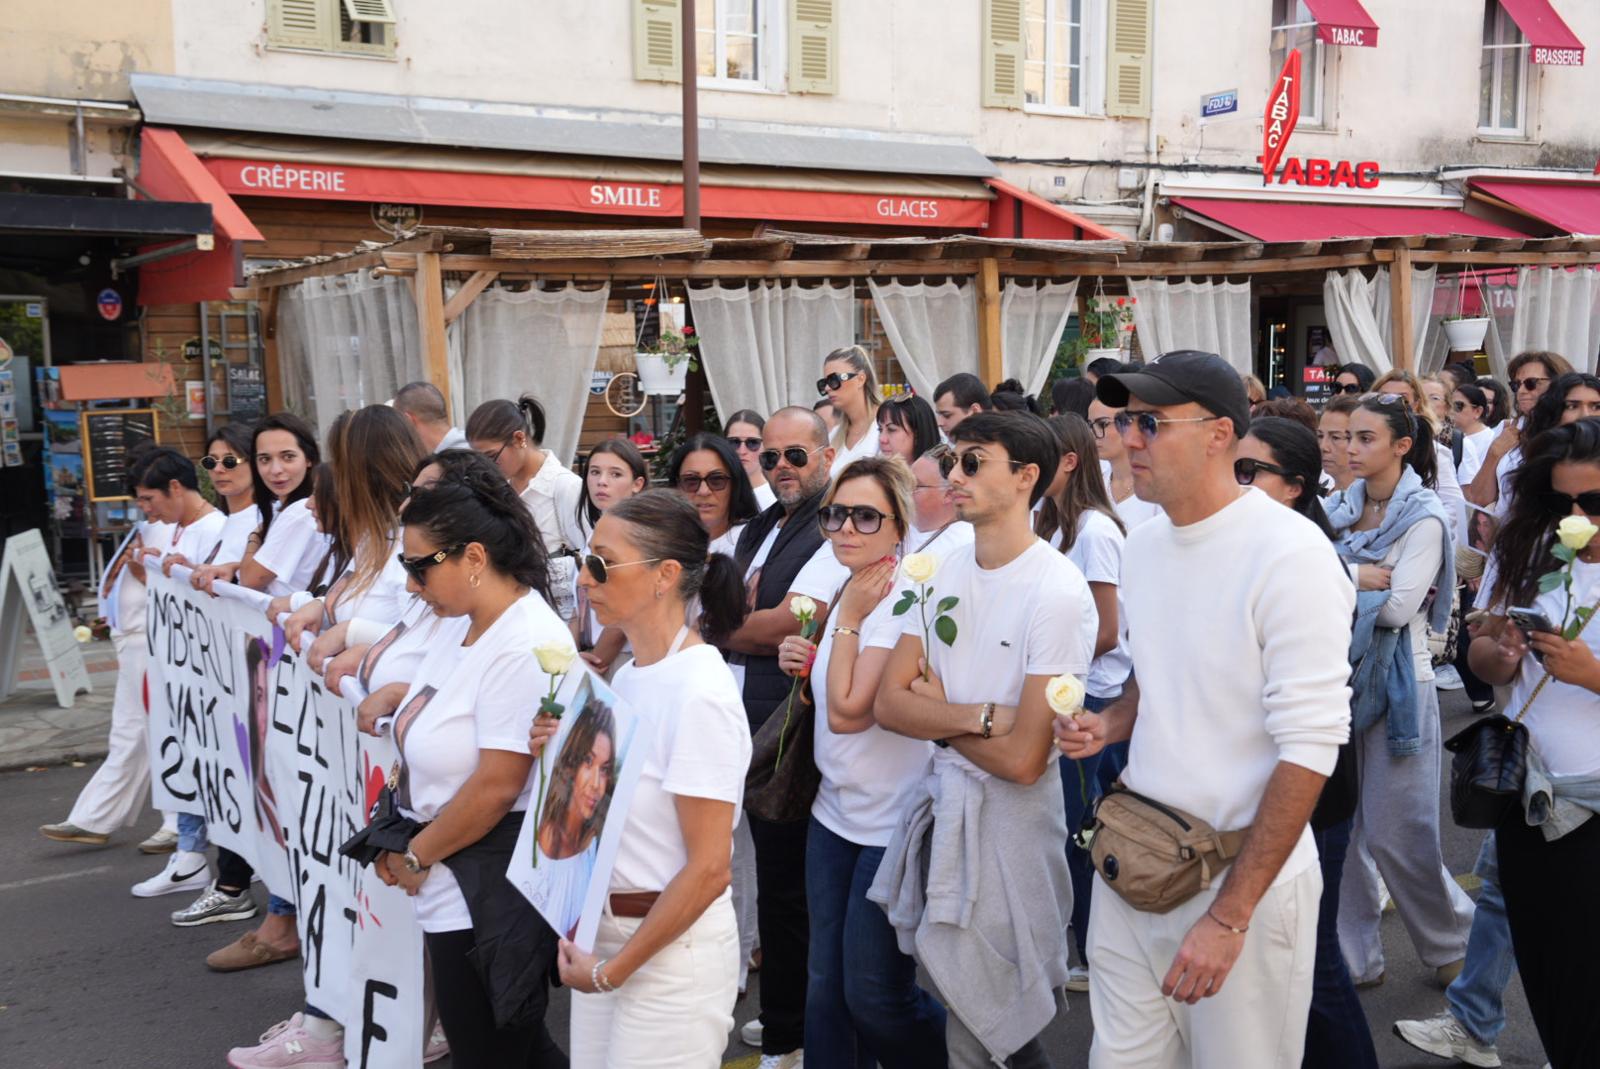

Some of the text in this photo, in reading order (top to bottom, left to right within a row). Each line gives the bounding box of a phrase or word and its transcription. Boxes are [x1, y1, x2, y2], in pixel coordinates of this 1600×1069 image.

[1331, 27, 1365, 46] TABAC
[1535, 47, 1582, 66] BRASSERIE
[1268, 76, 1293, 149] TABAC
[241, 163, 346, 193] CRÊPERIE
[590, 184, 661, 209] SMILE
[877, 198, 939, 219] GLACES
[1493, 289, 1515, 308] TA
